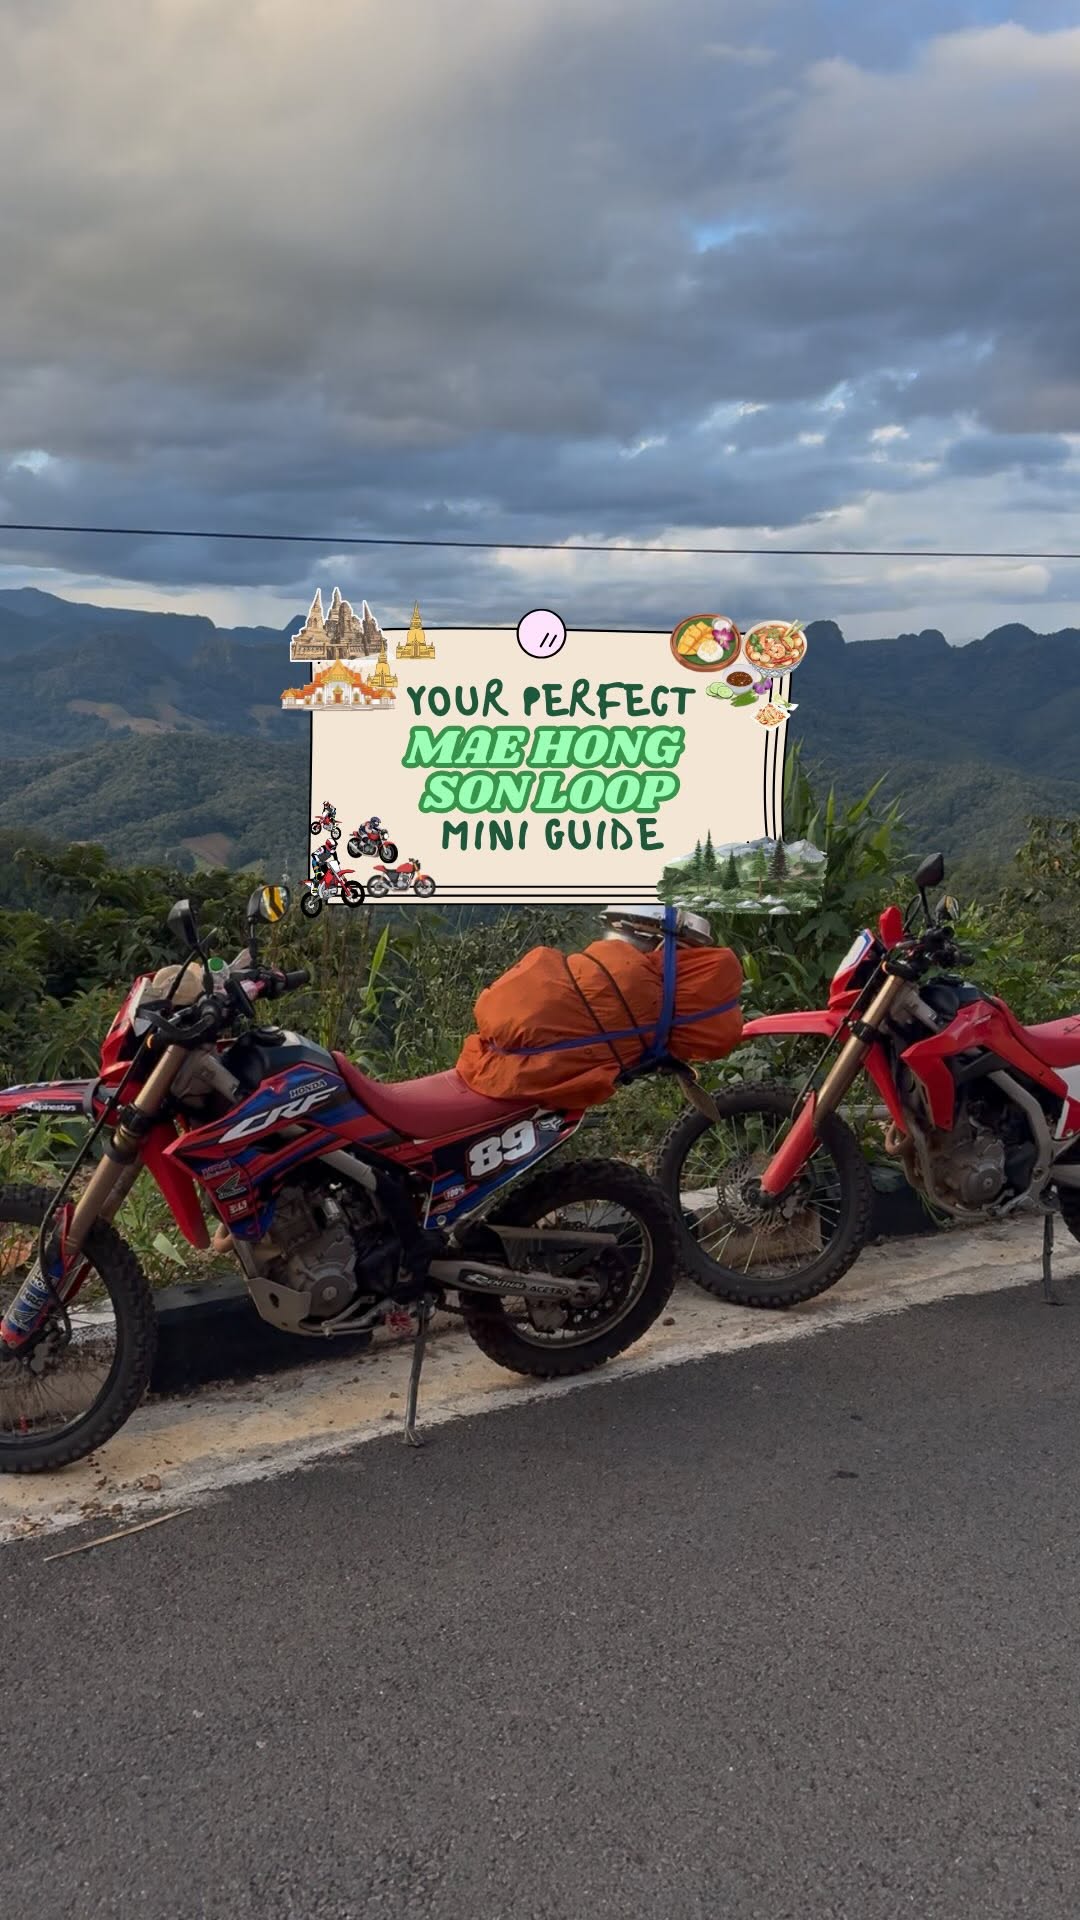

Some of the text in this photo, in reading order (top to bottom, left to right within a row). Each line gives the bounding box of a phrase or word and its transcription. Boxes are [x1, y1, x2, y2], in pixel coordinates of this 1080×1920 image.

[217, 1086, 339, 1144] CRF
[288, 1079, 328, 1099] HONDA
[469, 1120, 536, 1176] 89
